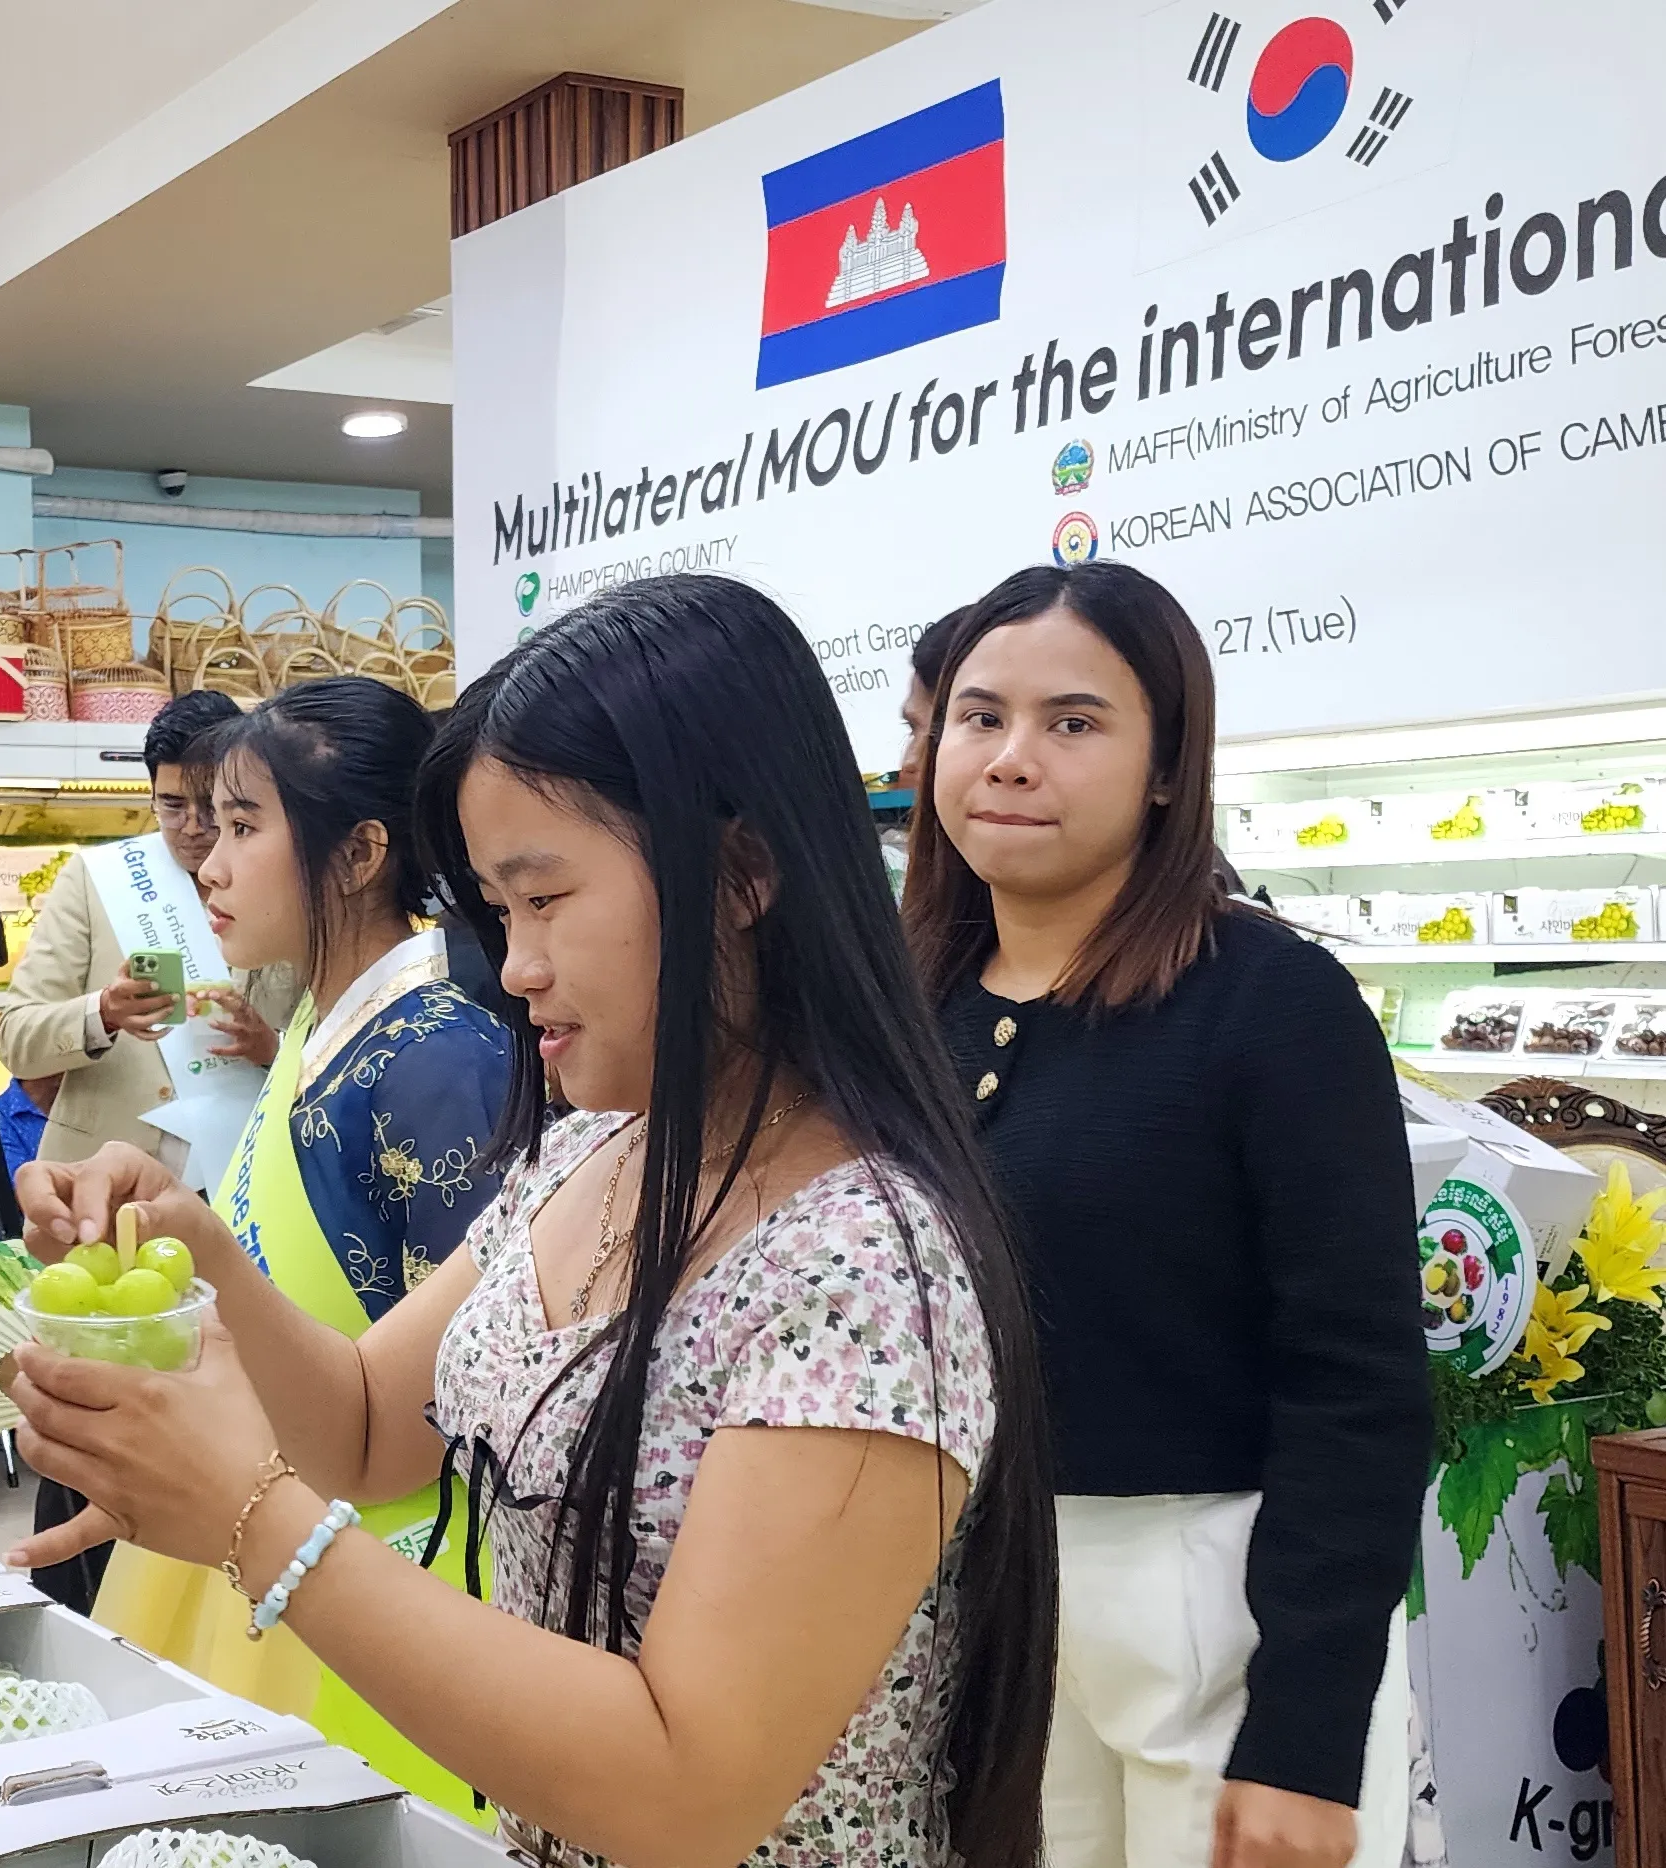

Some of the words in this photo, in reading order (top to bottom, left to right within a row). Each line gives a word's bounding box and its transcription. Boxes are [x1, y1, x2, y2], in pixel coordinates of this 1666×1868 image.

[1108, 402, 1308, 474] MAFF(Ministry
[1321, 385, 1351, 424] of
[1364, 342, 1552, 416] Agriculture
[493, 432, 755, 566] Multilateral
[756, 391, 902, 502] MOU
[909, 378, 998, 463] for
[1012, 338, 1117, 434] the
[1111, 498, 1232, 552] KOREAN
[1246, 446, 1472, 527] ASSOCIATION
[1488, 432, 1542, 477] OF
[658, 534, 738, 576] COUNTY
[811, 628, 862, 665] port
[149, 1760, 308, 1797] 샤인머스켓
